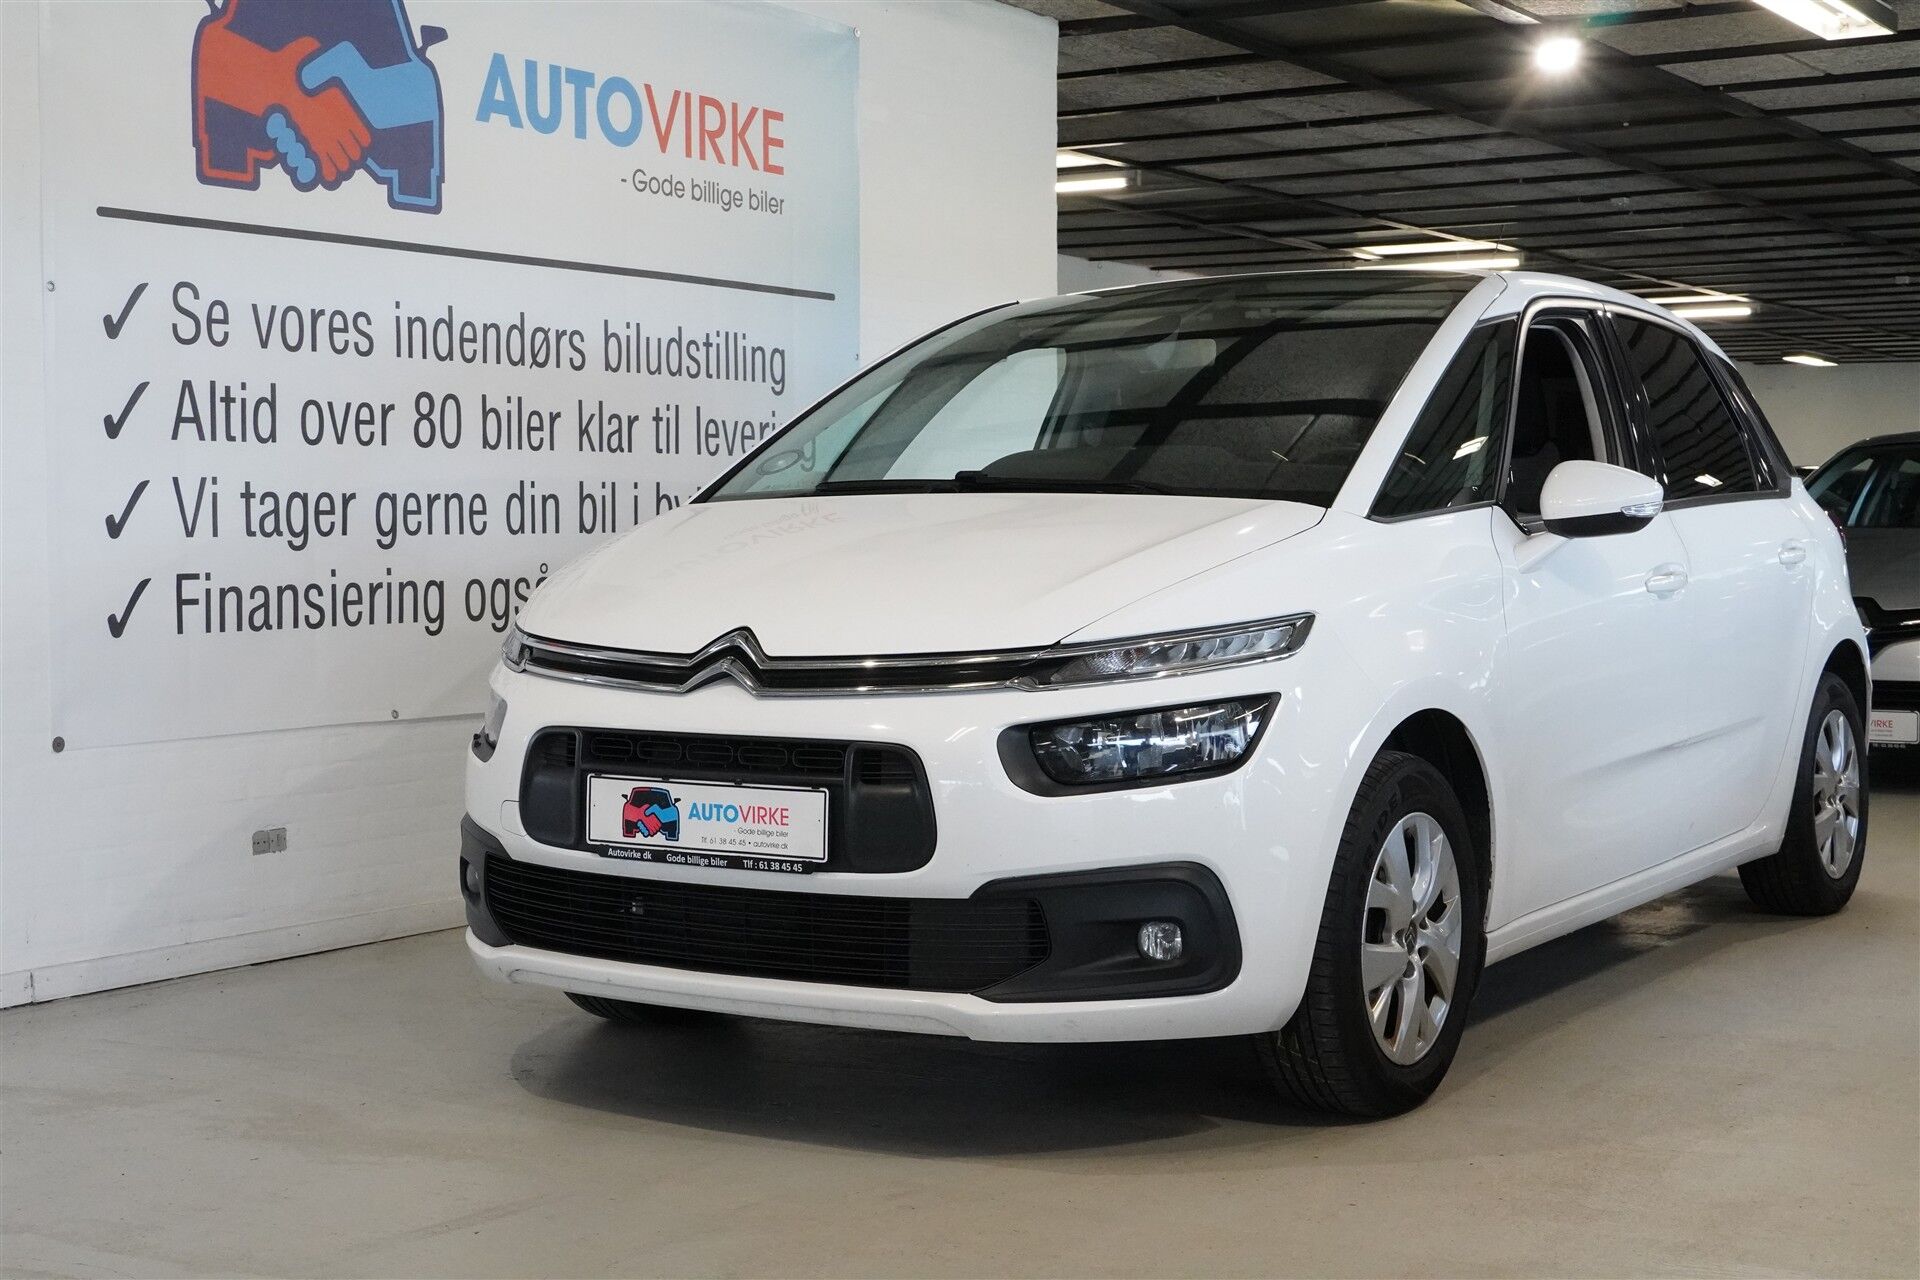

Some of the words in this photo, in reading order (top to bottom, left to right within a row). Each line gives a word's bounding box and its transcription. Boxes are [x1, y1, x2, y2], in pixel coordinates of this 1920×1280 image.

[475, 52, 784, 176] AUTOVIRKE
[632, 168, 685, 198] Gode
[691, 178, 743, 212] billige
[749, 188, 785, 215] biler
[171, 281, 230, 348] Se
[251, 303, 375, 358] vores
[394, 301, 587, 372] indendørs
[603, 319, 786, 397] biludstilling
[171, 379, 277, 444] Altid
[301, 399, 396, 447] over
[413, 391, 462, 449] 80
[481, 394, 562, 452] biler
[577, 400, 640, 454] klar
[652, 404, 680, 455] til
[172, 476, 219, 538] Vi
[240, 481, 357, 552] tager
[375, 491, 488, 550] gerne
[505, 480, 561, 535] din
[578, 481, 617, 534] bil
[633, 481, 639, 525] i
[175, 567, 445, 637] Finansiering
[688, 802, 789, 826] AUTOVIRKE
[737, 827, 756, 835] Gode
[756, 829, 775, 837] billige
[666, 853, 686, 863] Gode
[687, 855, 709, 866] billige
[710, 857, 728, 866] biler
[743, 860, 753, 868] Tlf
[759, 861, 769, 869] 61
[770, 862, 780, 870] 38
[781, 863, 791, 871] 45
[792, 864, 803, 872] 45
